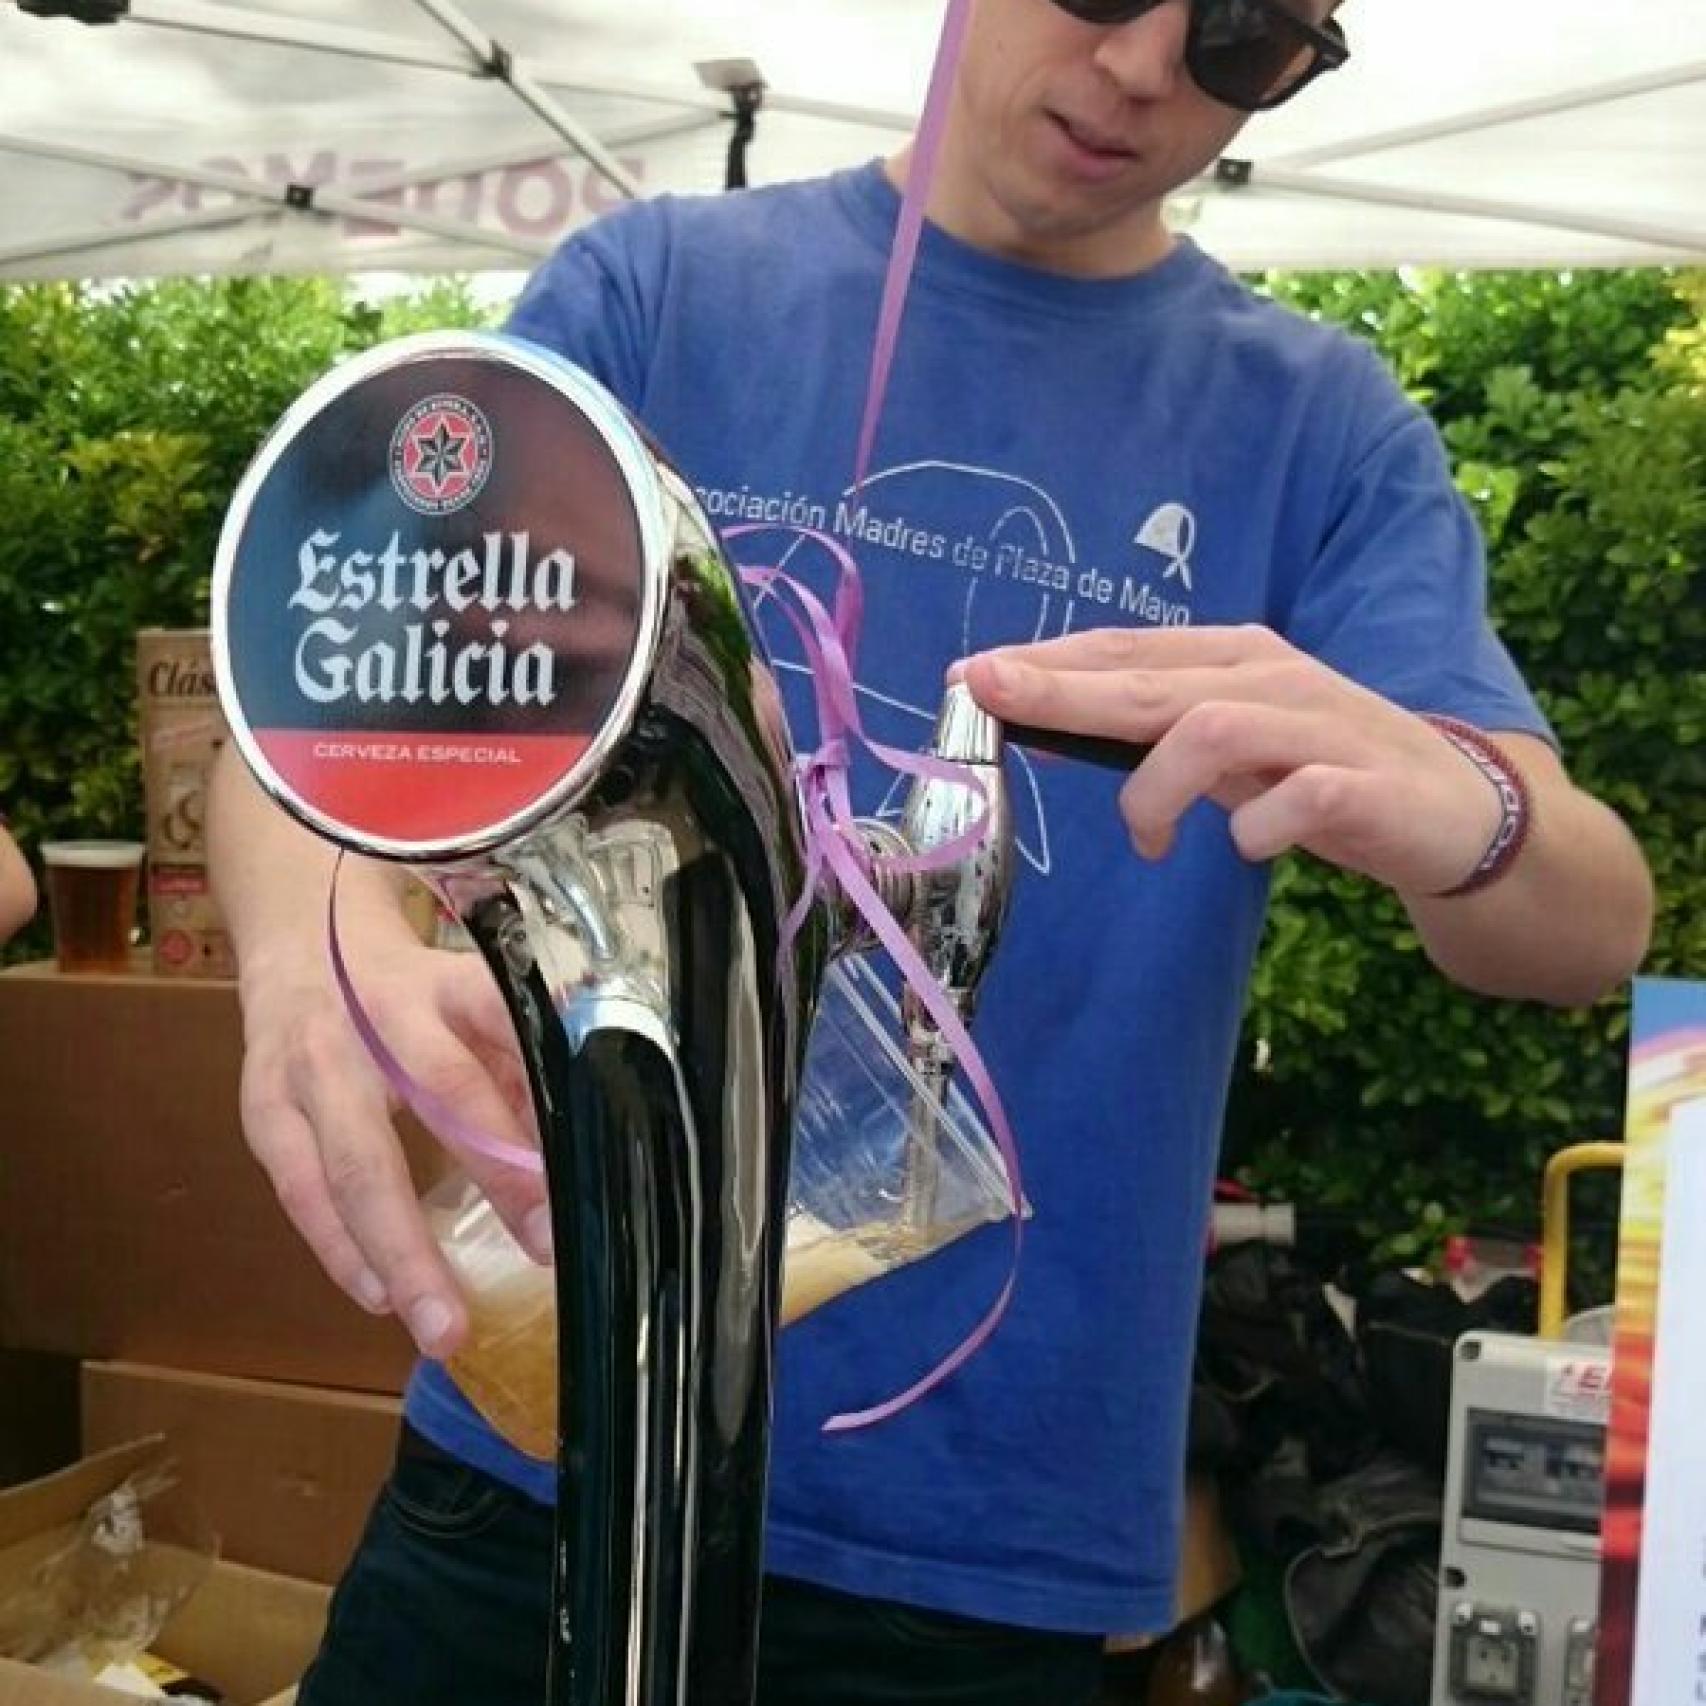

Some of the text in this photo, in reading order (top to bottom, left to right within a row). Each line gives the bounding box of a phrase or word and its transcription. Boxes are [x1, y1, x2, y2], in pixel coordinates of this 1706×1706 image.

[288, 529, 576, 612] Estrella
[832, 502, 946, 559] Madres
[952, 536, 988, 570] de
[994, 543, 1070, 591] Plaza
[1077, 567, 1113, 604] de
[295, 617, 556, 705] Galicia
[314, 742, 521, 763] CERVEZA ESPECIAL
